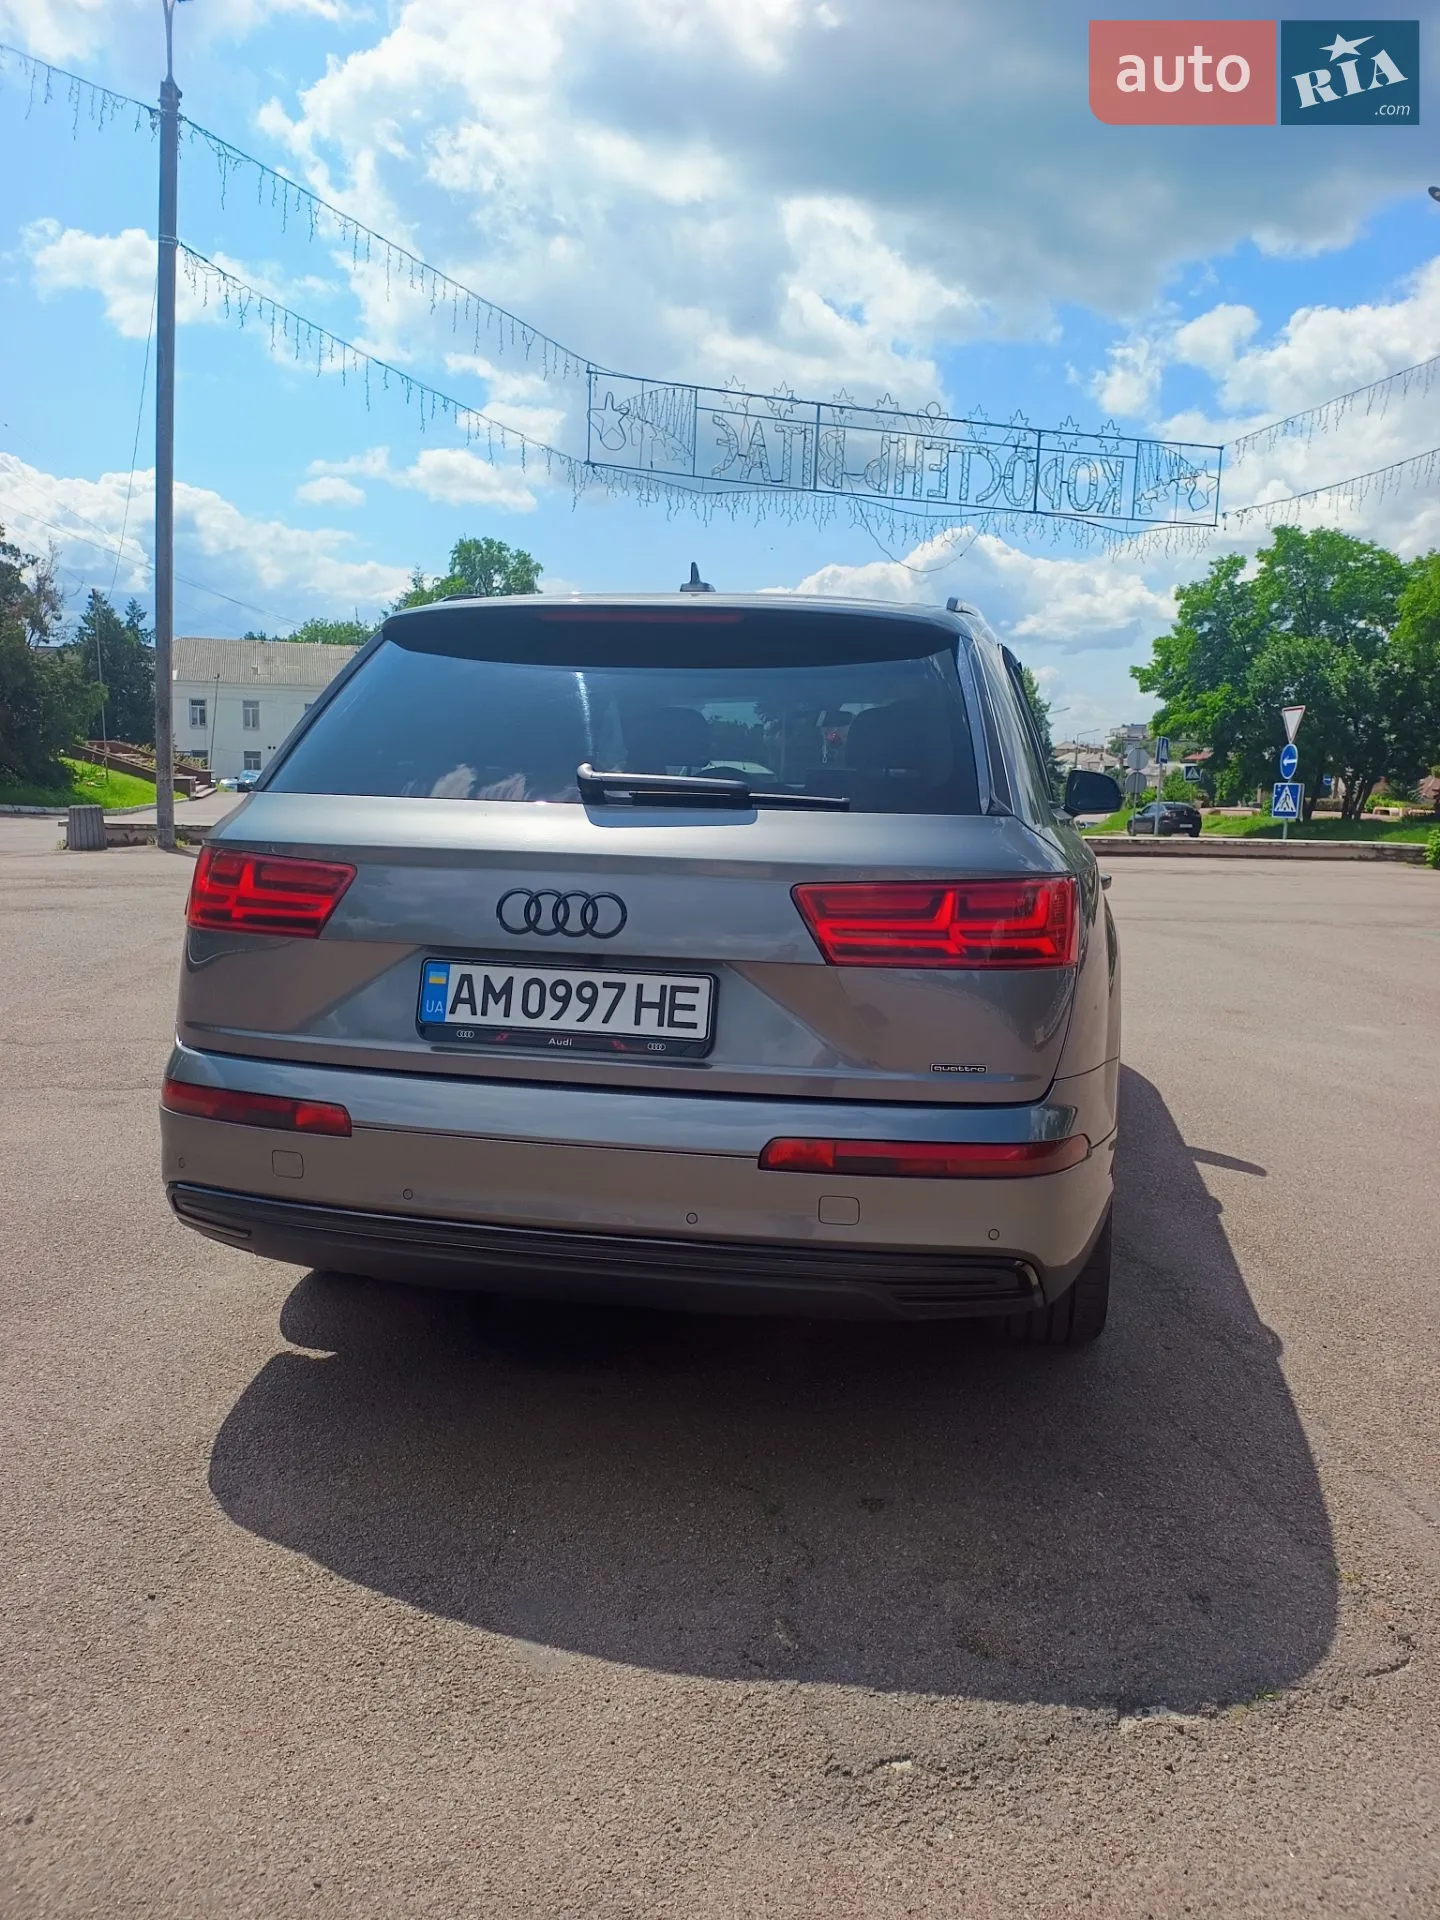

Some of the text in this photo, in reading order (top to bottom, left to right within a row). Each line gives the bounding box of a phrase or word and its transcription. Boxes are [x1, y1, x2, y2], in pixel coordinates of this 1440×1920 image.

[425, 999, 444, 1014] UA
[548, 1037, 573, 1047] Audi
[933, 1065, 986, 1073] quattro
